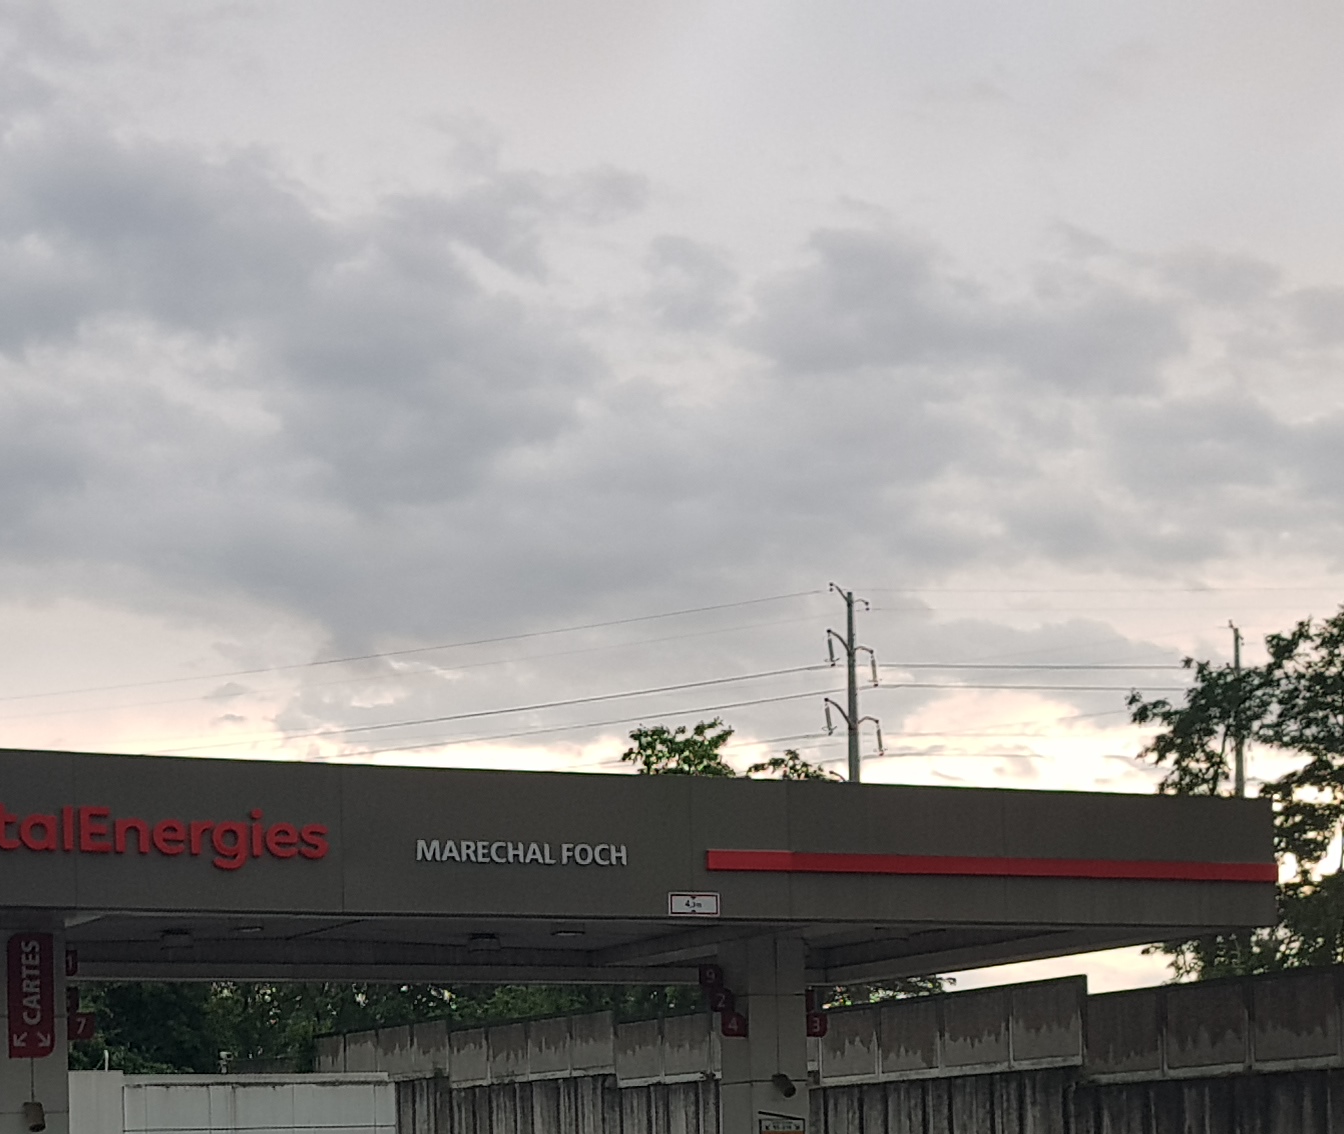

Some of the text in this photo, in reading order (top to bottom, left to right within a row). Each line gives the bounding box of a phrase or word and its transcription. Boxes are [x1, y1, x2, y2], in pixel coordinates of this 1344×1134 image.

[416, 839, 627, 866] MARECHAL FOCH
[21, 940, 41, 1026] CARTES
[76, 1016, 87, 1035] 7
[728, 1017, 739, 1032] 4
[811, 1017, 821, 1032] 3
